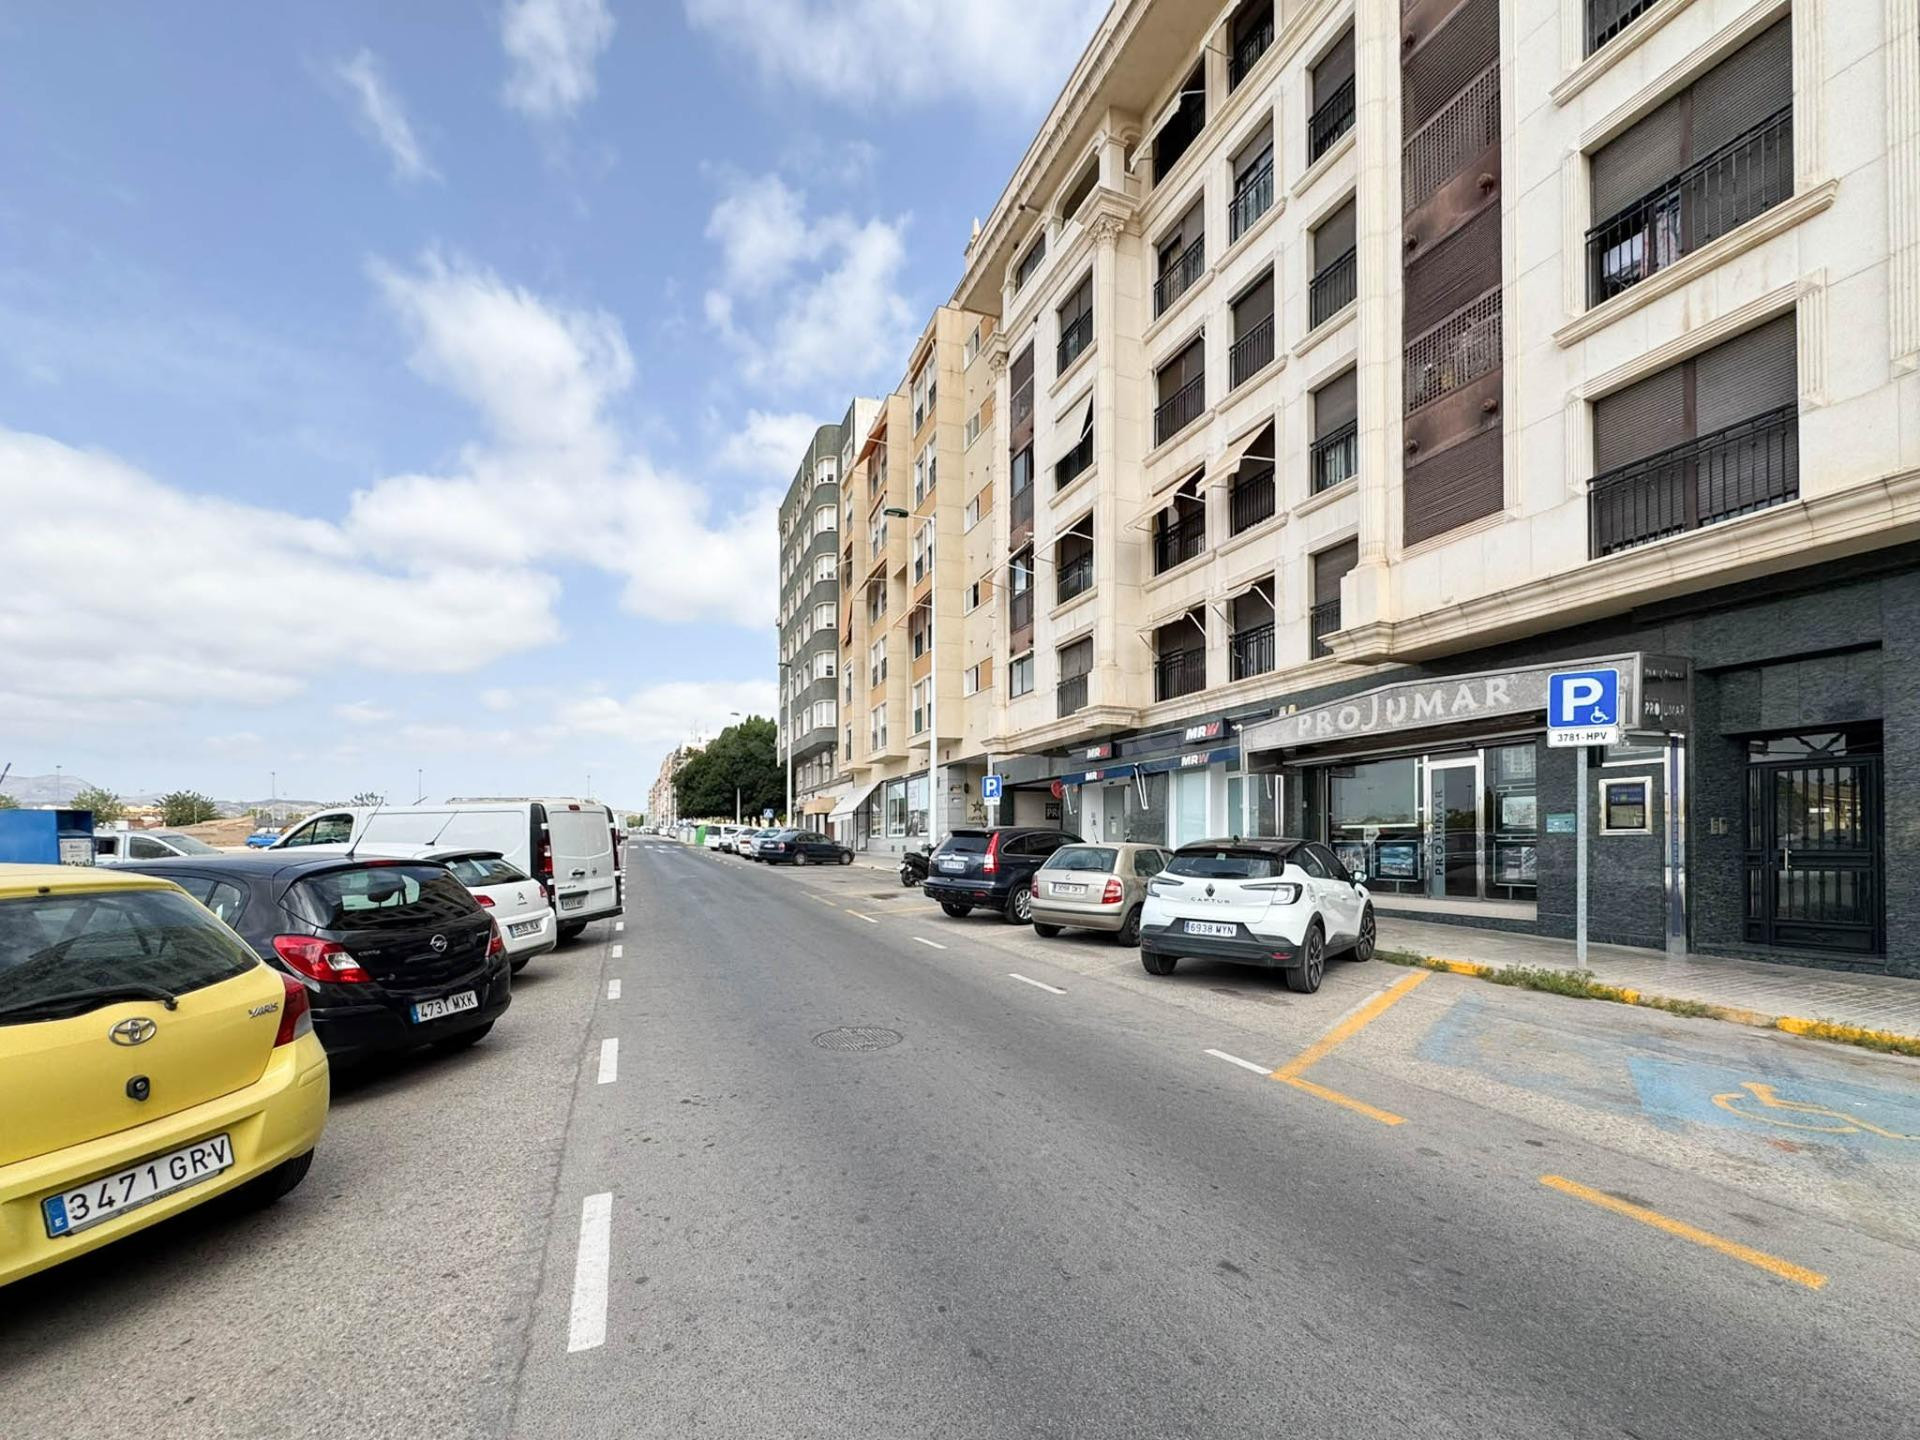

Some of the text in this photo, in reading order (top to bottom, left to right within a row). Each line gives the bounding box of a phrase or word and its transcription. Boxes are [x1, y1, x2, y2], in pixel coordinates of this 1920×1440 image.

[1297, 677, 1510, 737] PROJUMAR
[1562, 678, 1603, 722] P
[1186, 722, 1220, 741] MRW
[1557, 731, 1607, 743] 3781-HPV
[1086, 743, 1110, 760] MRW
[1181, 752, 1210, 767] MRW
[1085, 770, 1105, 781] MRW
[986, 778, 997, 796] P
[1434, 789, 1445, 876] PROJUMAR
[1190, 923, 1213, 934] 6938
[420, 1000, 449, 1018] 4731
[68, 1172, 158, 1221] 3471
